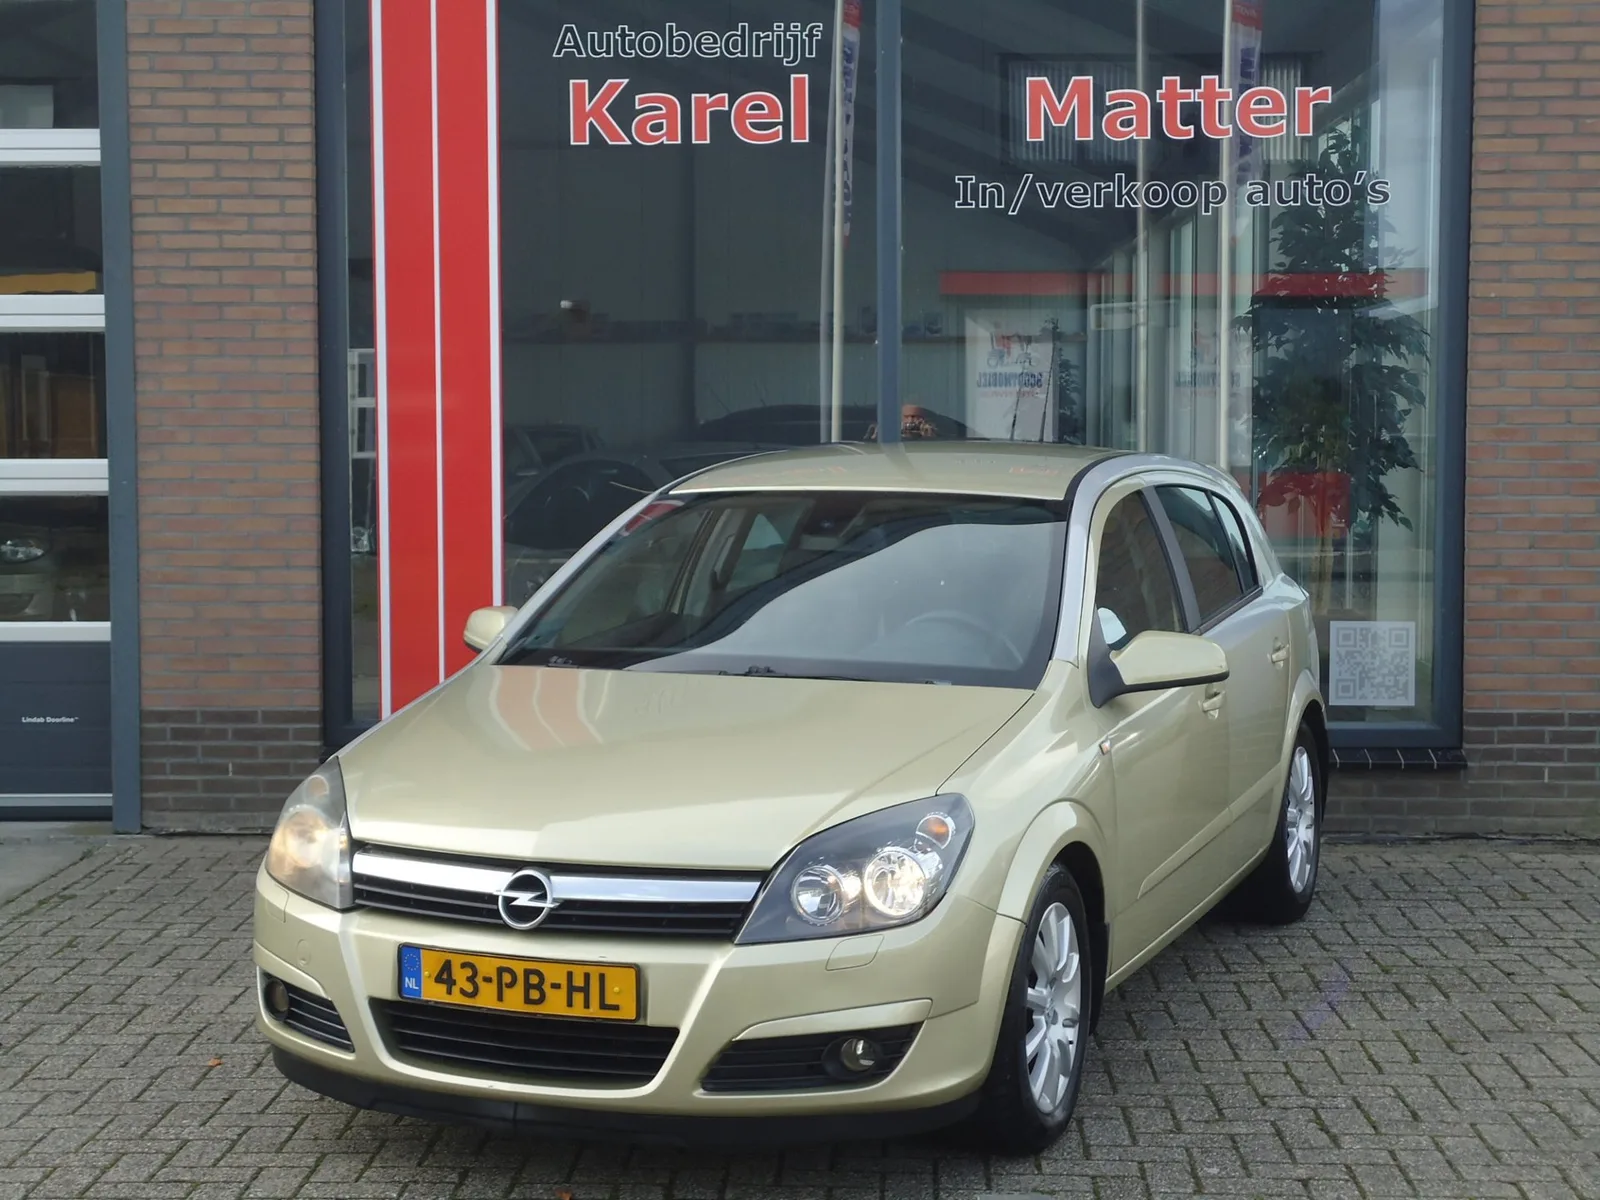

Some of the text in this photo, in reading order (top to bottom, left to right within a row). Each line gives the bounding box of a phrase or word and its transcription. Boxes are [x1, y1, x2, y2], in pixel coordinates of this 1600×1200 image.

[552, 22, 823, 66] Autobedrijf
[569, 73, 810, 145] Karel
[1026, 75, 1332, 141] Matter
[954, 171, 1391, 216] In/verkoop auto's
[404, 959, 620, 1011] NL 43-PB-HL
